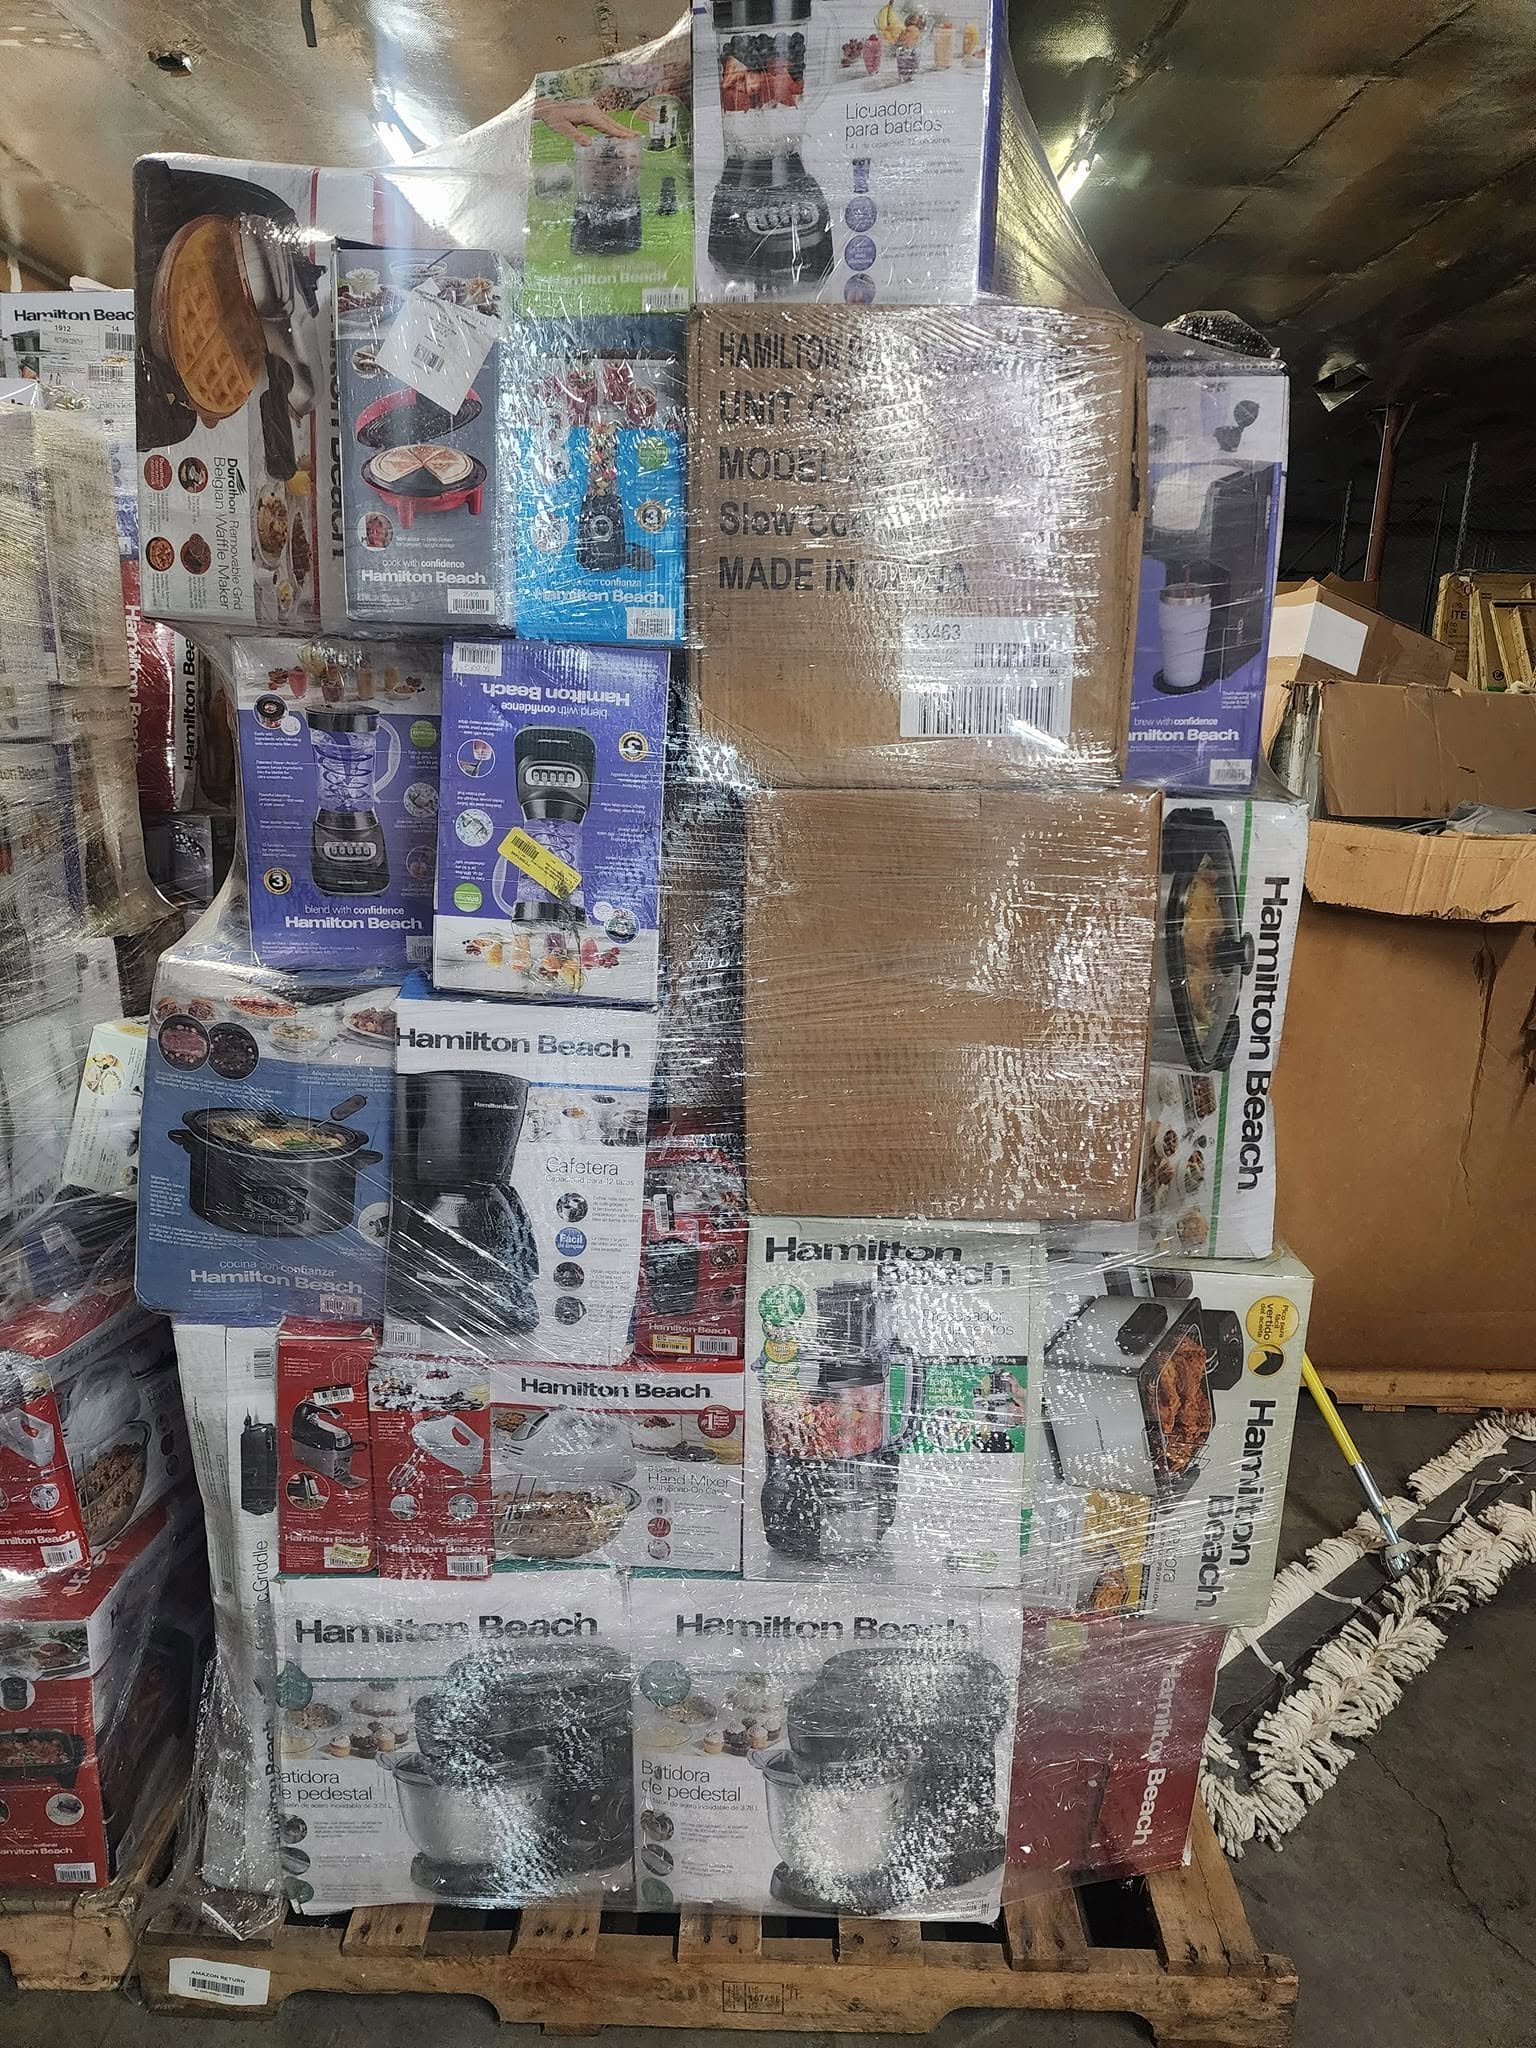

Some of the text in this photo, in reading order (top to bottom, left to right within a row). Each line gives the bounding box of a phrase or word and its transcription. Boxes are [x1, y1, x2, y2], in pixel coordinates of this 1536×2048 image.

[845, 100, 922, 120] Licuadora
[845, 116, 943, 140] para batidos
[14, 309, 90, 322] Hamilton
[54, 324, 72, 333] 1912
[719, 390, 796, 425] UNIT
[719, 446, 828, 483] MODEL
[719, 501, 796, 537] Slow
[212, 456, 230, 610] Belgian Waffle Maker
[227, 458, 243, 610] Durathon Removable Grid
[403, 559, 420, 568] with
[421, 559, 465, 568] confidence
[361, 569, 486, 585] Hamilton Beach
[601, 577, 641, 587] confianza
[719, 556, 814, 592] MADE
[825, 558, 856, 592] IN
[612, 588, 665, 604] Beach
[546, 687, 630, 707] Hamilton
[500, 701, 608, 720] blend with confidence
[183, 680, 196, 771] Hamilton
[1134, 716, 1218, 726] brew with confidence
[1187, 728, 1240, 741] Beach
[271, 874, 282, 888] 3
[304, 905, 404, 915] blend with confidence
[285, 916, 423, 930] Hamilton Beach
[396, 1027, 632, 1059] Hamilton Beach
[1237, 875, 1290, 1191] Hamilton Beach
[546, 1156, 619, 1176] Cafetera
[587, 1177, 603, 1186] para
[606, 1177, 614, 1185] 12
[765, 1237, 963, 1263] Hamilton
[219, 1260, 257, 1269] cocina
[280, 1264, 336, 1278] confianza
[190, 1269, 363, 1294] Hamilton Beach
[648, 1323, 731, 1336] Hamilton Beach
[1263, 1303, 1274, 1341] vertido
[521, 1377, 711, 1400] Hamilton Beach
[648, 1472, 729, 1488] Hand Mixer
[1196, 1400, 1276, 1608] Hamilton Beach
[37, 1530, 77, 1544] Beach
[285, 1533, 369, 1545] Hamilton Beach
[384, 1544, 486, 1554] Hamilton Beach
[252, 1540, 269, 1591] Griddle
[296, 1612, 599, 1645] Hamilton Beach
[676, 1613, 844, 1640] Hamilton
[641, 1759, 710, 1784] Batidora
[297, 1785, 373, 1803] pedestal
[641, 1777, 741, 1802] de pedestal
[1131, 1767, 1167, 1848] Beach
[40, 1847, 73, 1855] Beach
[190, 1970, 246, 1984] AMAZON RETURN
